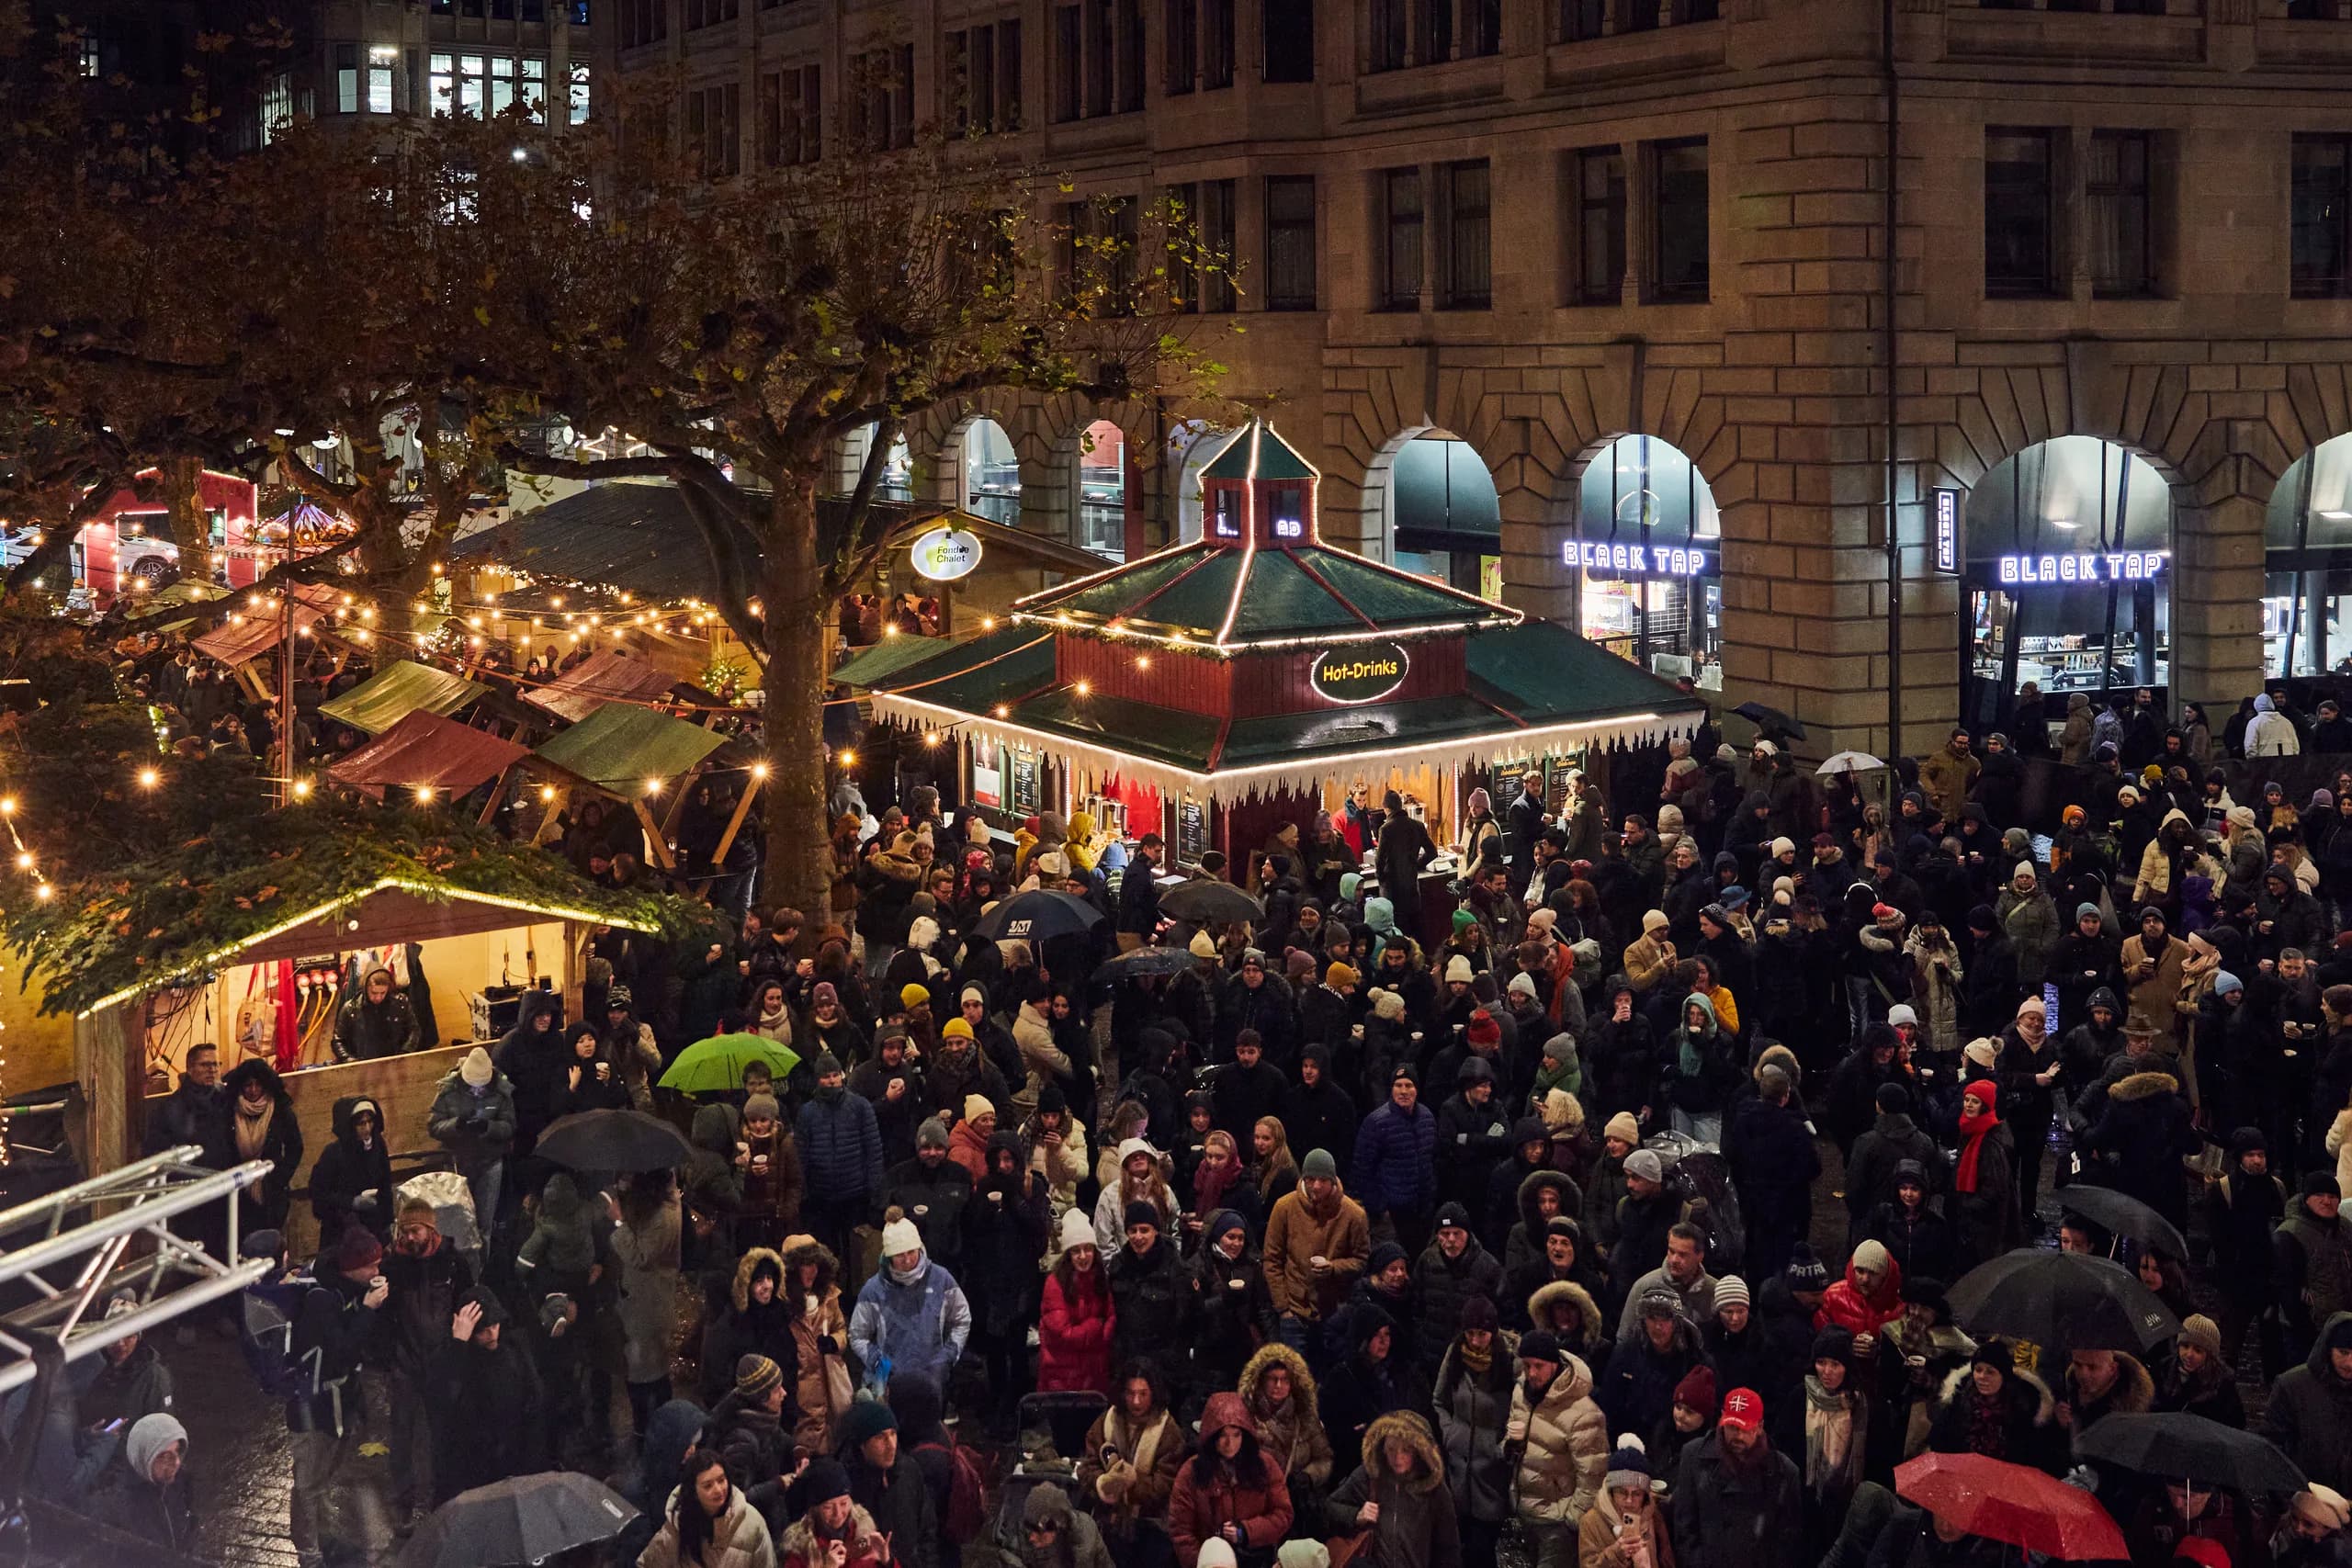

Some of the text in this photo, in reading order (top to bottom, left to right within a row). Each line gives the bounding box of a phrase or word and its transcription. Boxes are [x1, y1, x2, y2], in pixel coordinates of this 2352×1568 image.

[1564, 541, 1704, 574] BLACK TAP
[2000, 553, 2161, 582] BLACK TAP
[1323, 659, 1397, 682] Hot-Drinks
